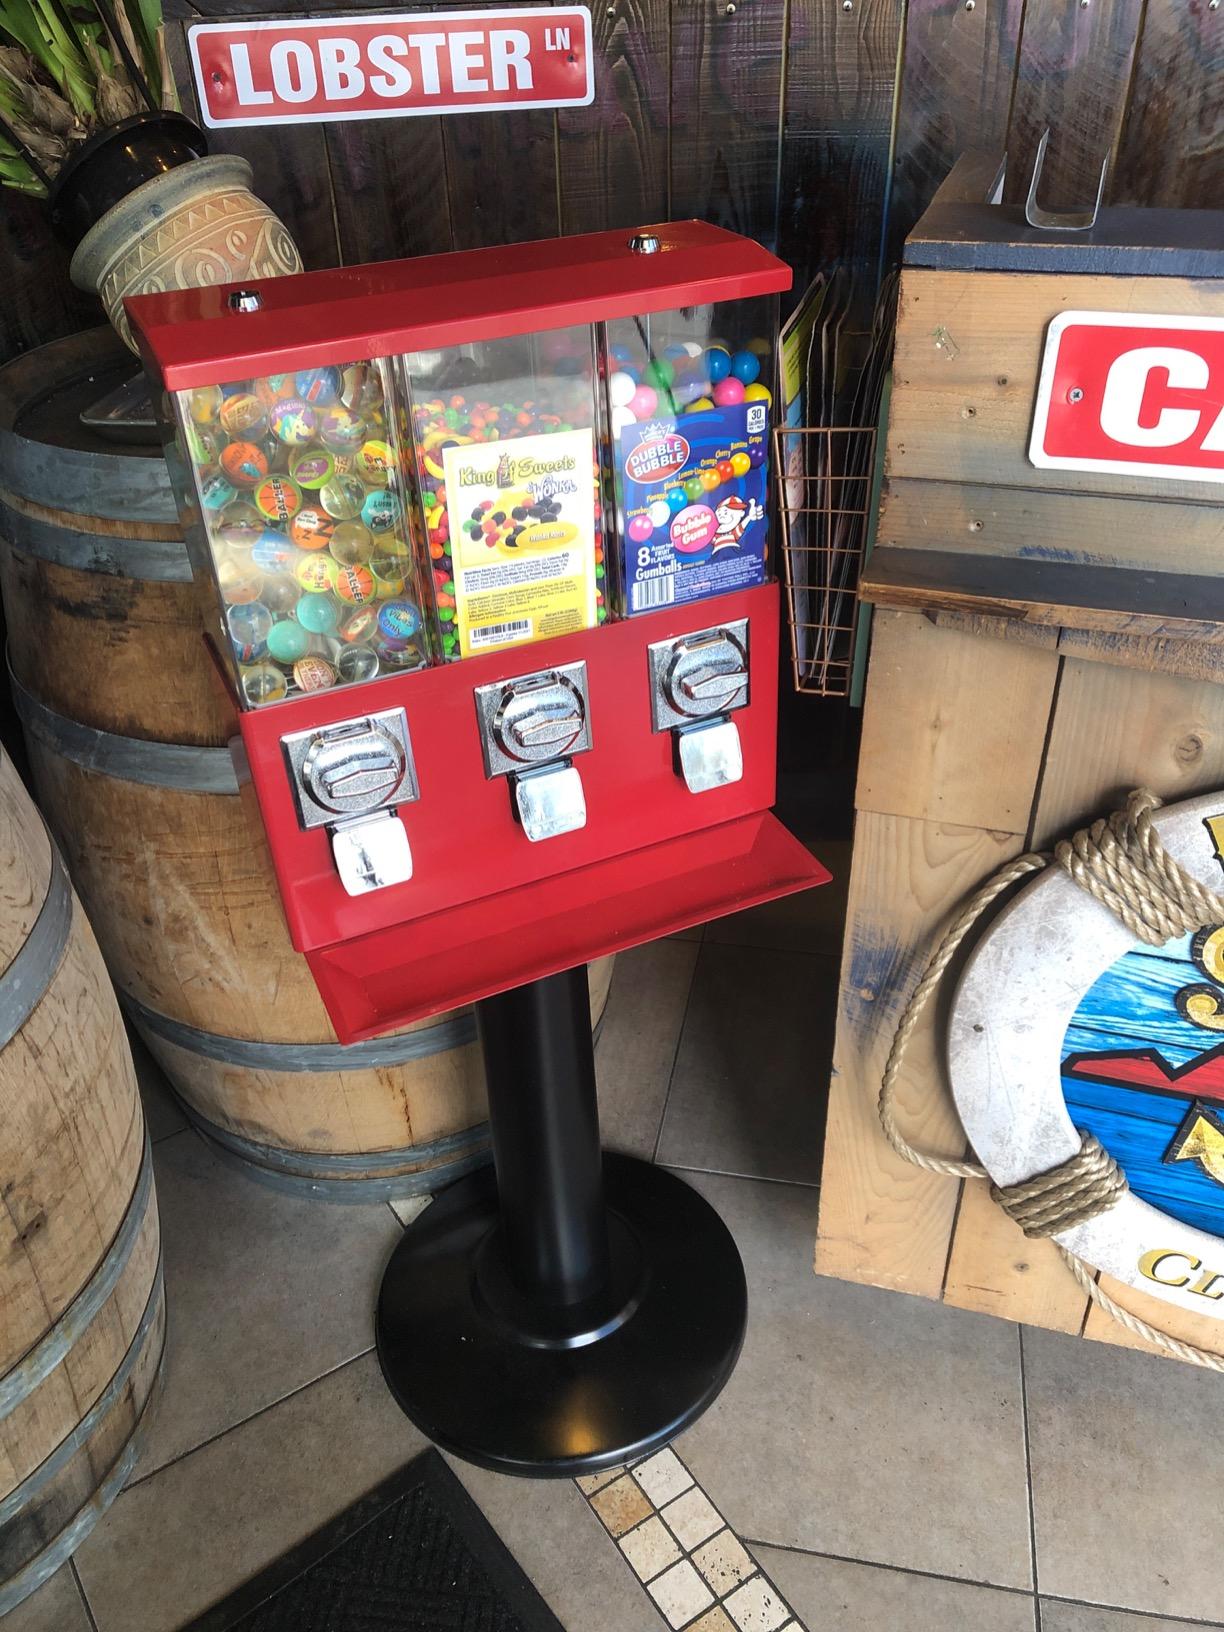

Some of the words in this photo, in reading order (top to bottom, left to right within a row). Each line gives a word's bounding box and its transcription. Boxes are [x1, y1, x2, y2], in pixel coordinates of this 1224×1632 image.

[230, 30, 534, 106] LOBSTER
[544, 27, 571, 52] LN
[751, 408, 762, 421] 30
[630, 440, 682, 467] DUBBLE
[633, 451, 685, 478] BUBBLE
[459, 466, 496, 488] King
[518, 455, 576, 478] Sweets
[272, 478, 288, 521] BALLER
[673, 511, 712, 538] Bubble
[682, 527, 708, 545] Gum
[635, 559, 682, 581] Gumballs
[637, 546, 651, 567] 8
